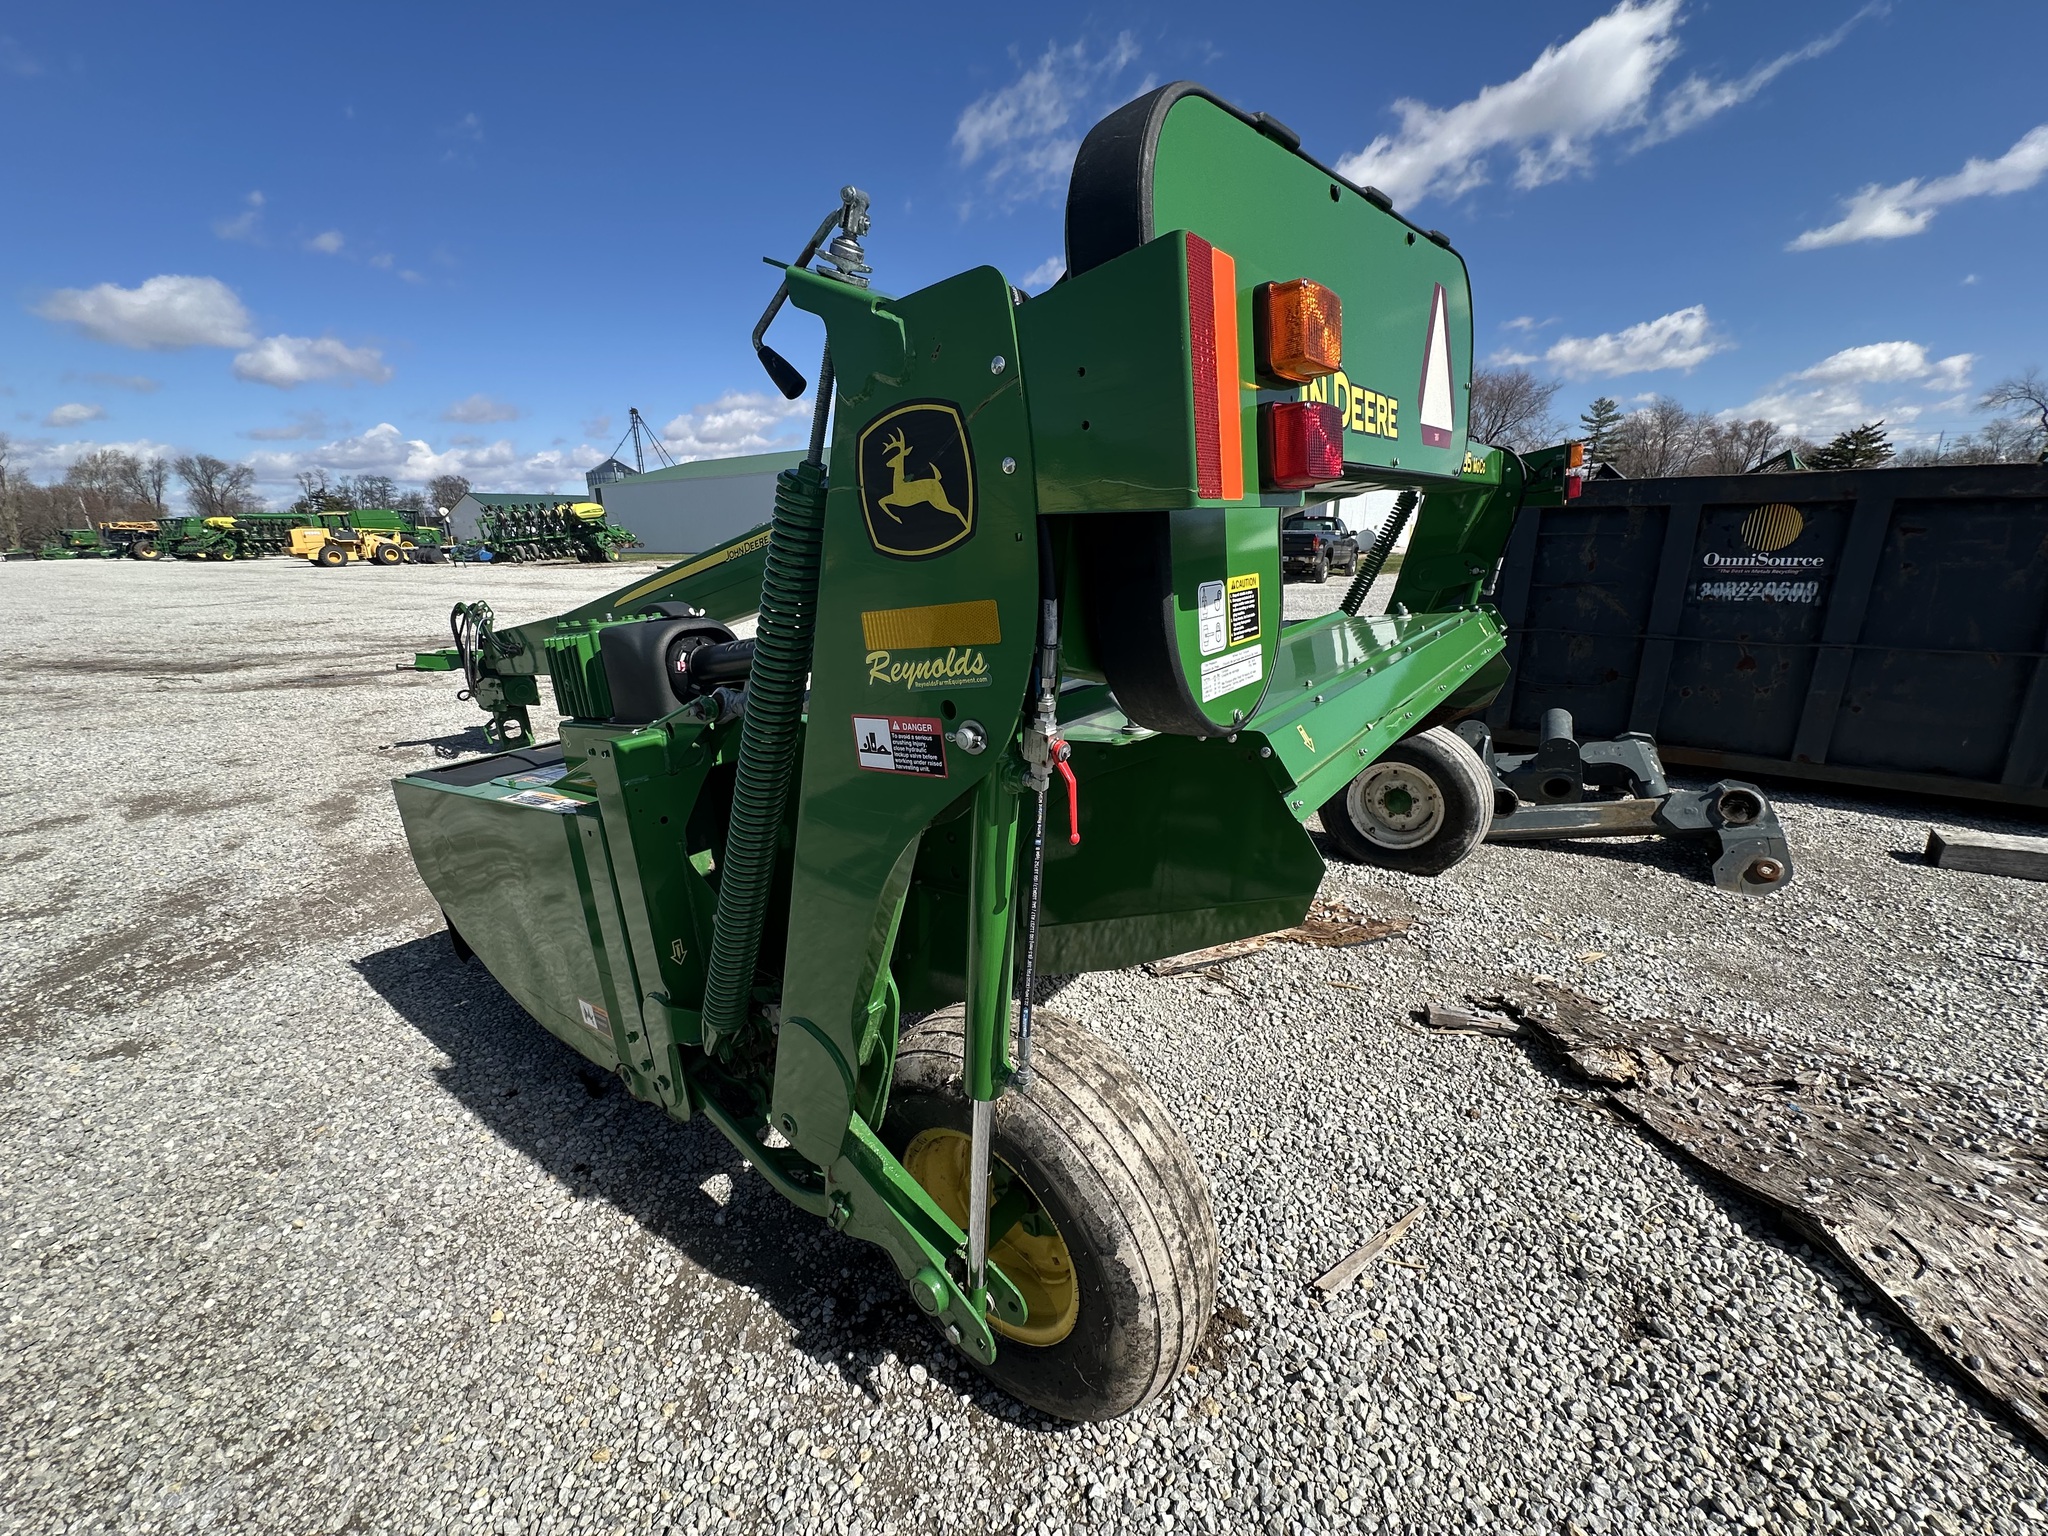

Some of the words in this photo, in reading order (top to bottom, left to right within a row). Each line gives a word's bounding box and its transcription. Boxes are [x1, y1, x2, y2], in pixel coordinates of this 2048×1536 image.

[1334, 371, 1398, 438] DEERE
[727, 546, 744, 559] JOHN
[744, 536, 768, 551] DEERE
[1703, 552, 1824, 567] OmniSource
[1236, 577, 1256, 589] CAUTION
[865, 647, 988, 690] Reynolds
[914, 677, 988, 688] ReynoldsFarmEquipment.com
[902, 723, 932, 732] DANGER
[896, 764, 919, 772] harvesting
